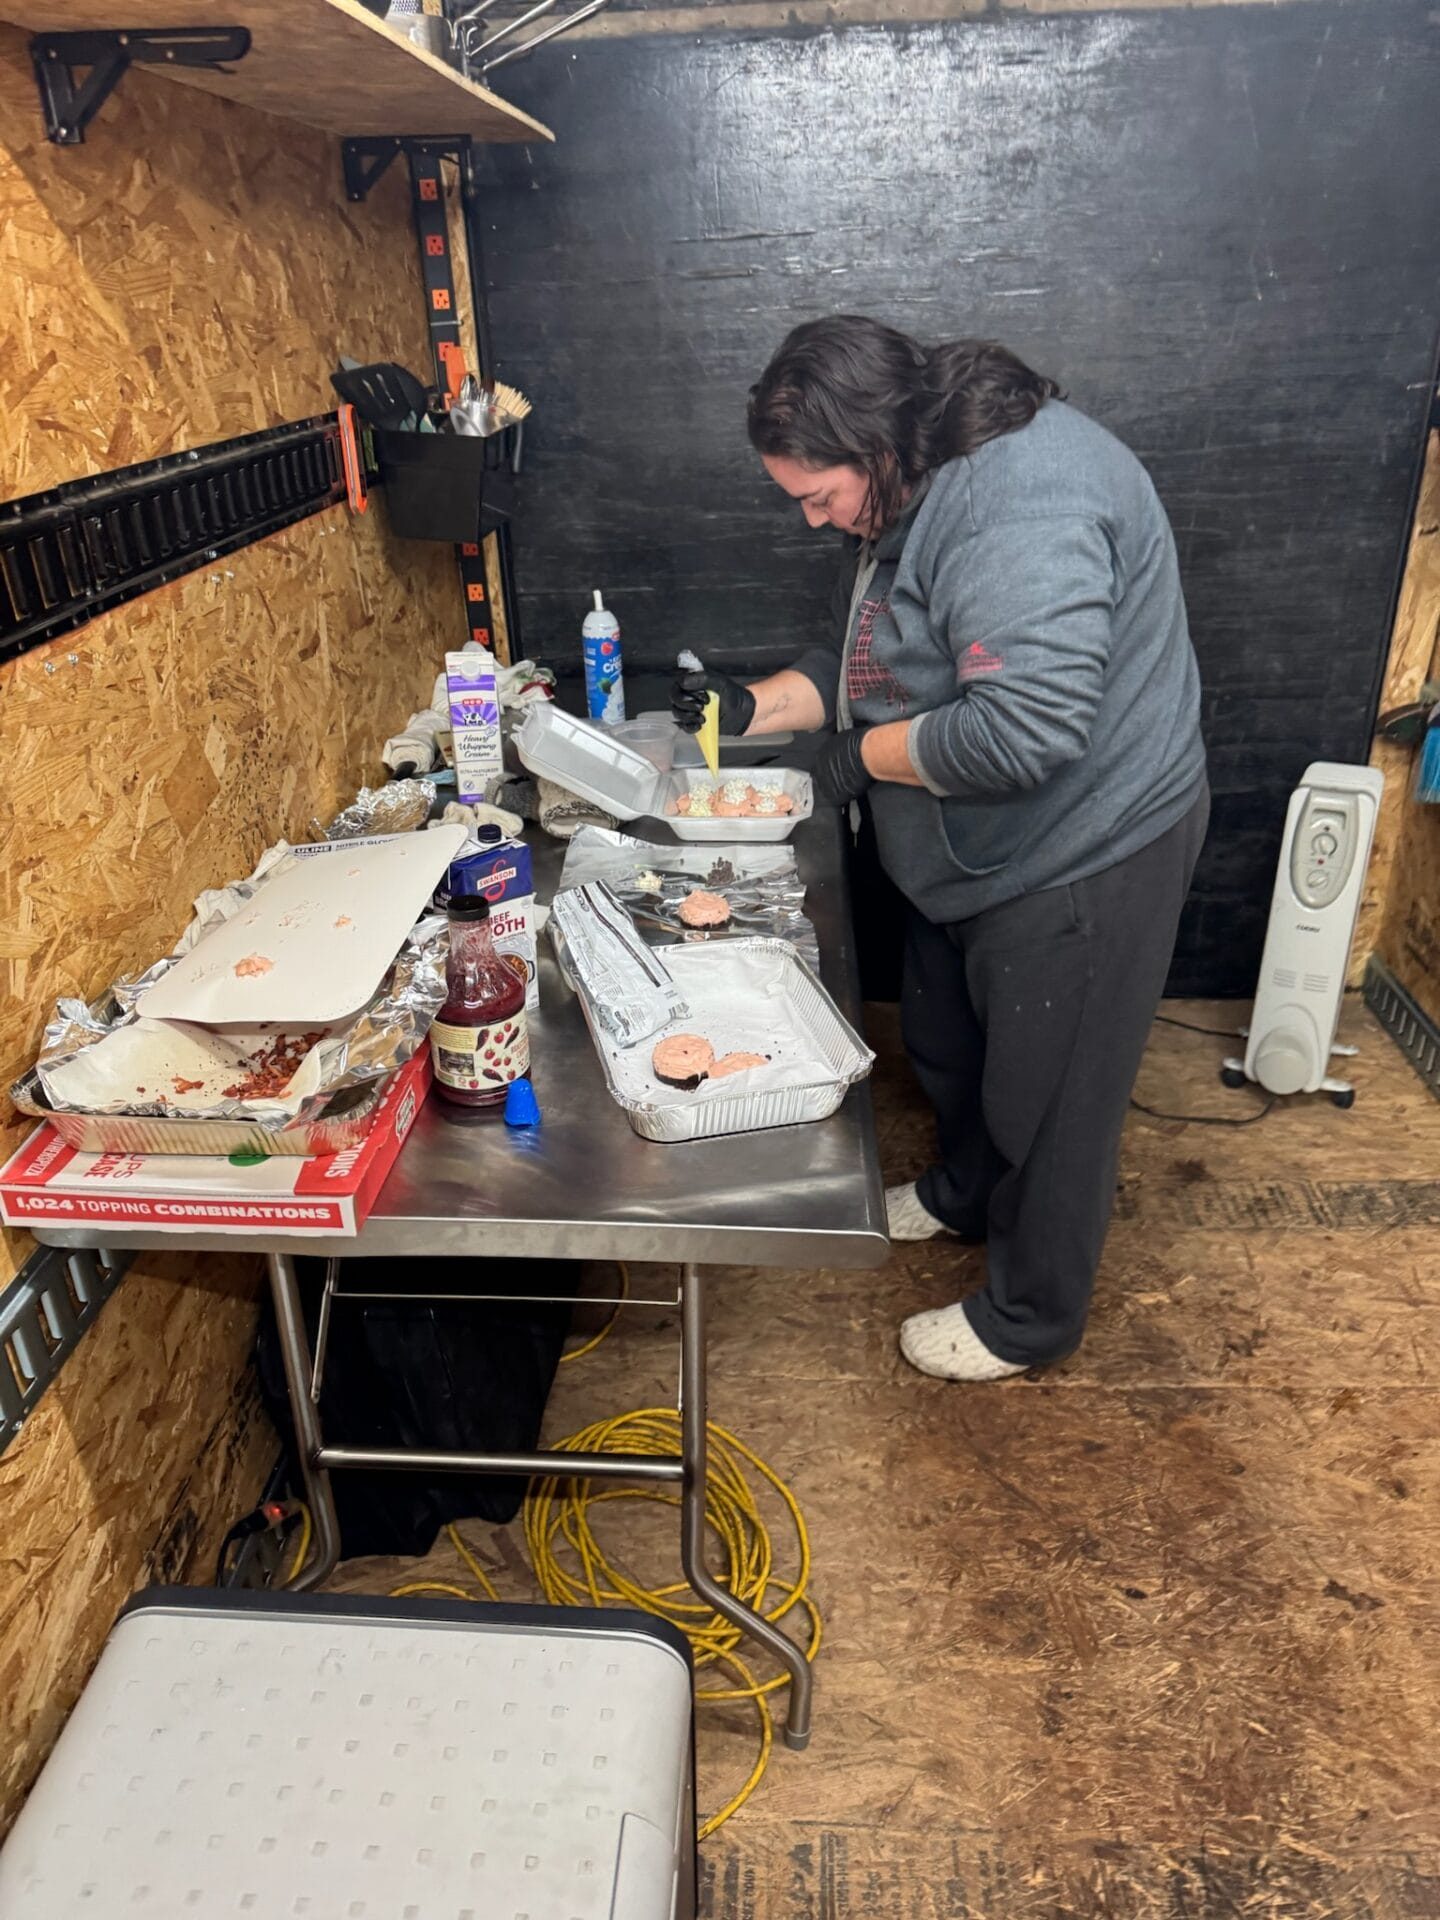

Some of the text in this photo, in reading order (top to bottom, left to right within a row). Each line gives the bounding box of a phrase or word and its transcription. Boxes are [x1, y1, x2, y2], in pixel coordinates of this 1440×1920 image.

[457, 743, 497, 751] Whipping
[294, 845, 331, 853] ULINE
[479, 869, 515, 886] SWANSON
[491, 916, 526, 938] OTH
[16, 1197, 331, 1220] 1,024 TOPPING COMBINATIONS
